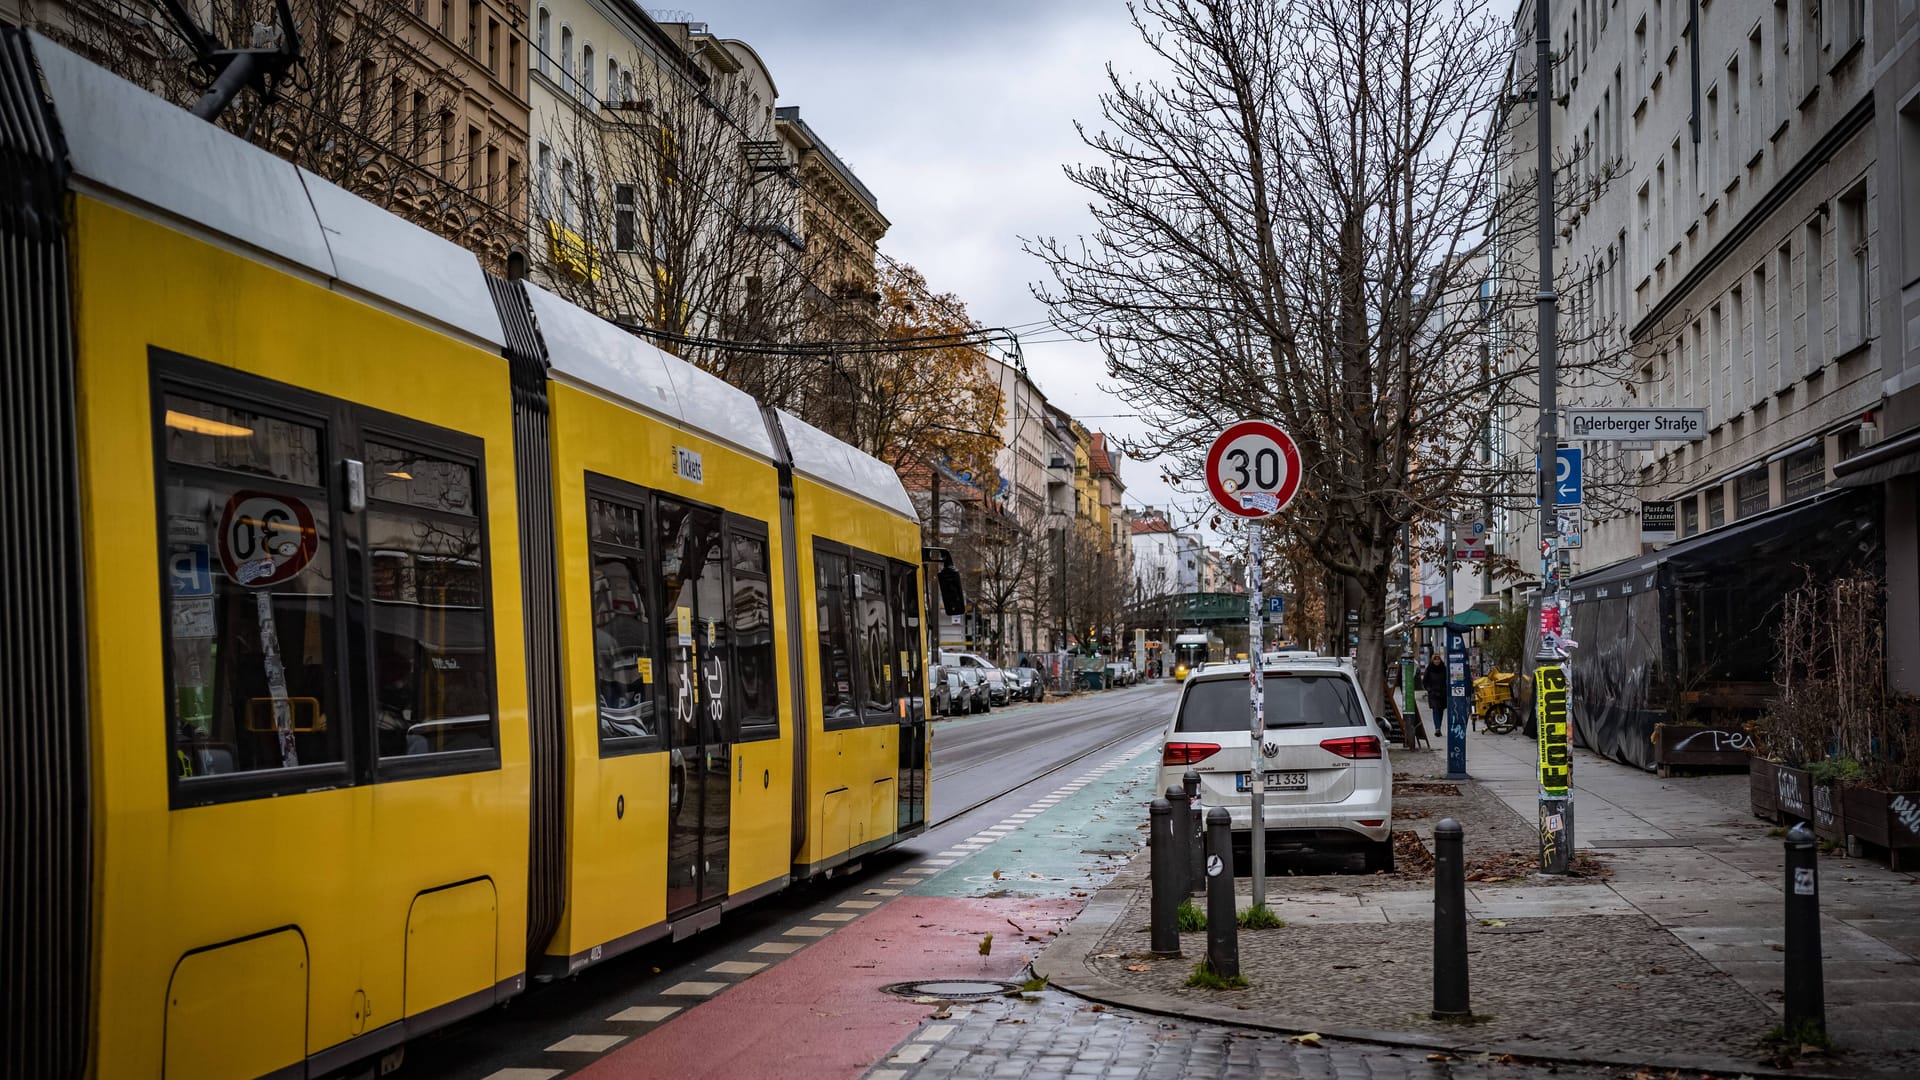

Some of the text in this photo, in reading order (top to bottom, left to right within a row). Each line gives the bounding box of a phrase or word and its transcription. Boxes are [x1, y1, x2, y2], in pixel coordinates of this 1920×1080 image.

[1573, 416, 1698, 434] Oderberger Straße
[679, 451, 702, 481] Tickets
[1227, 448, 1279, 490] 30
[1643, 505, 1665, 513] Pasta
[1542, 669, 1567, 787] Forma
